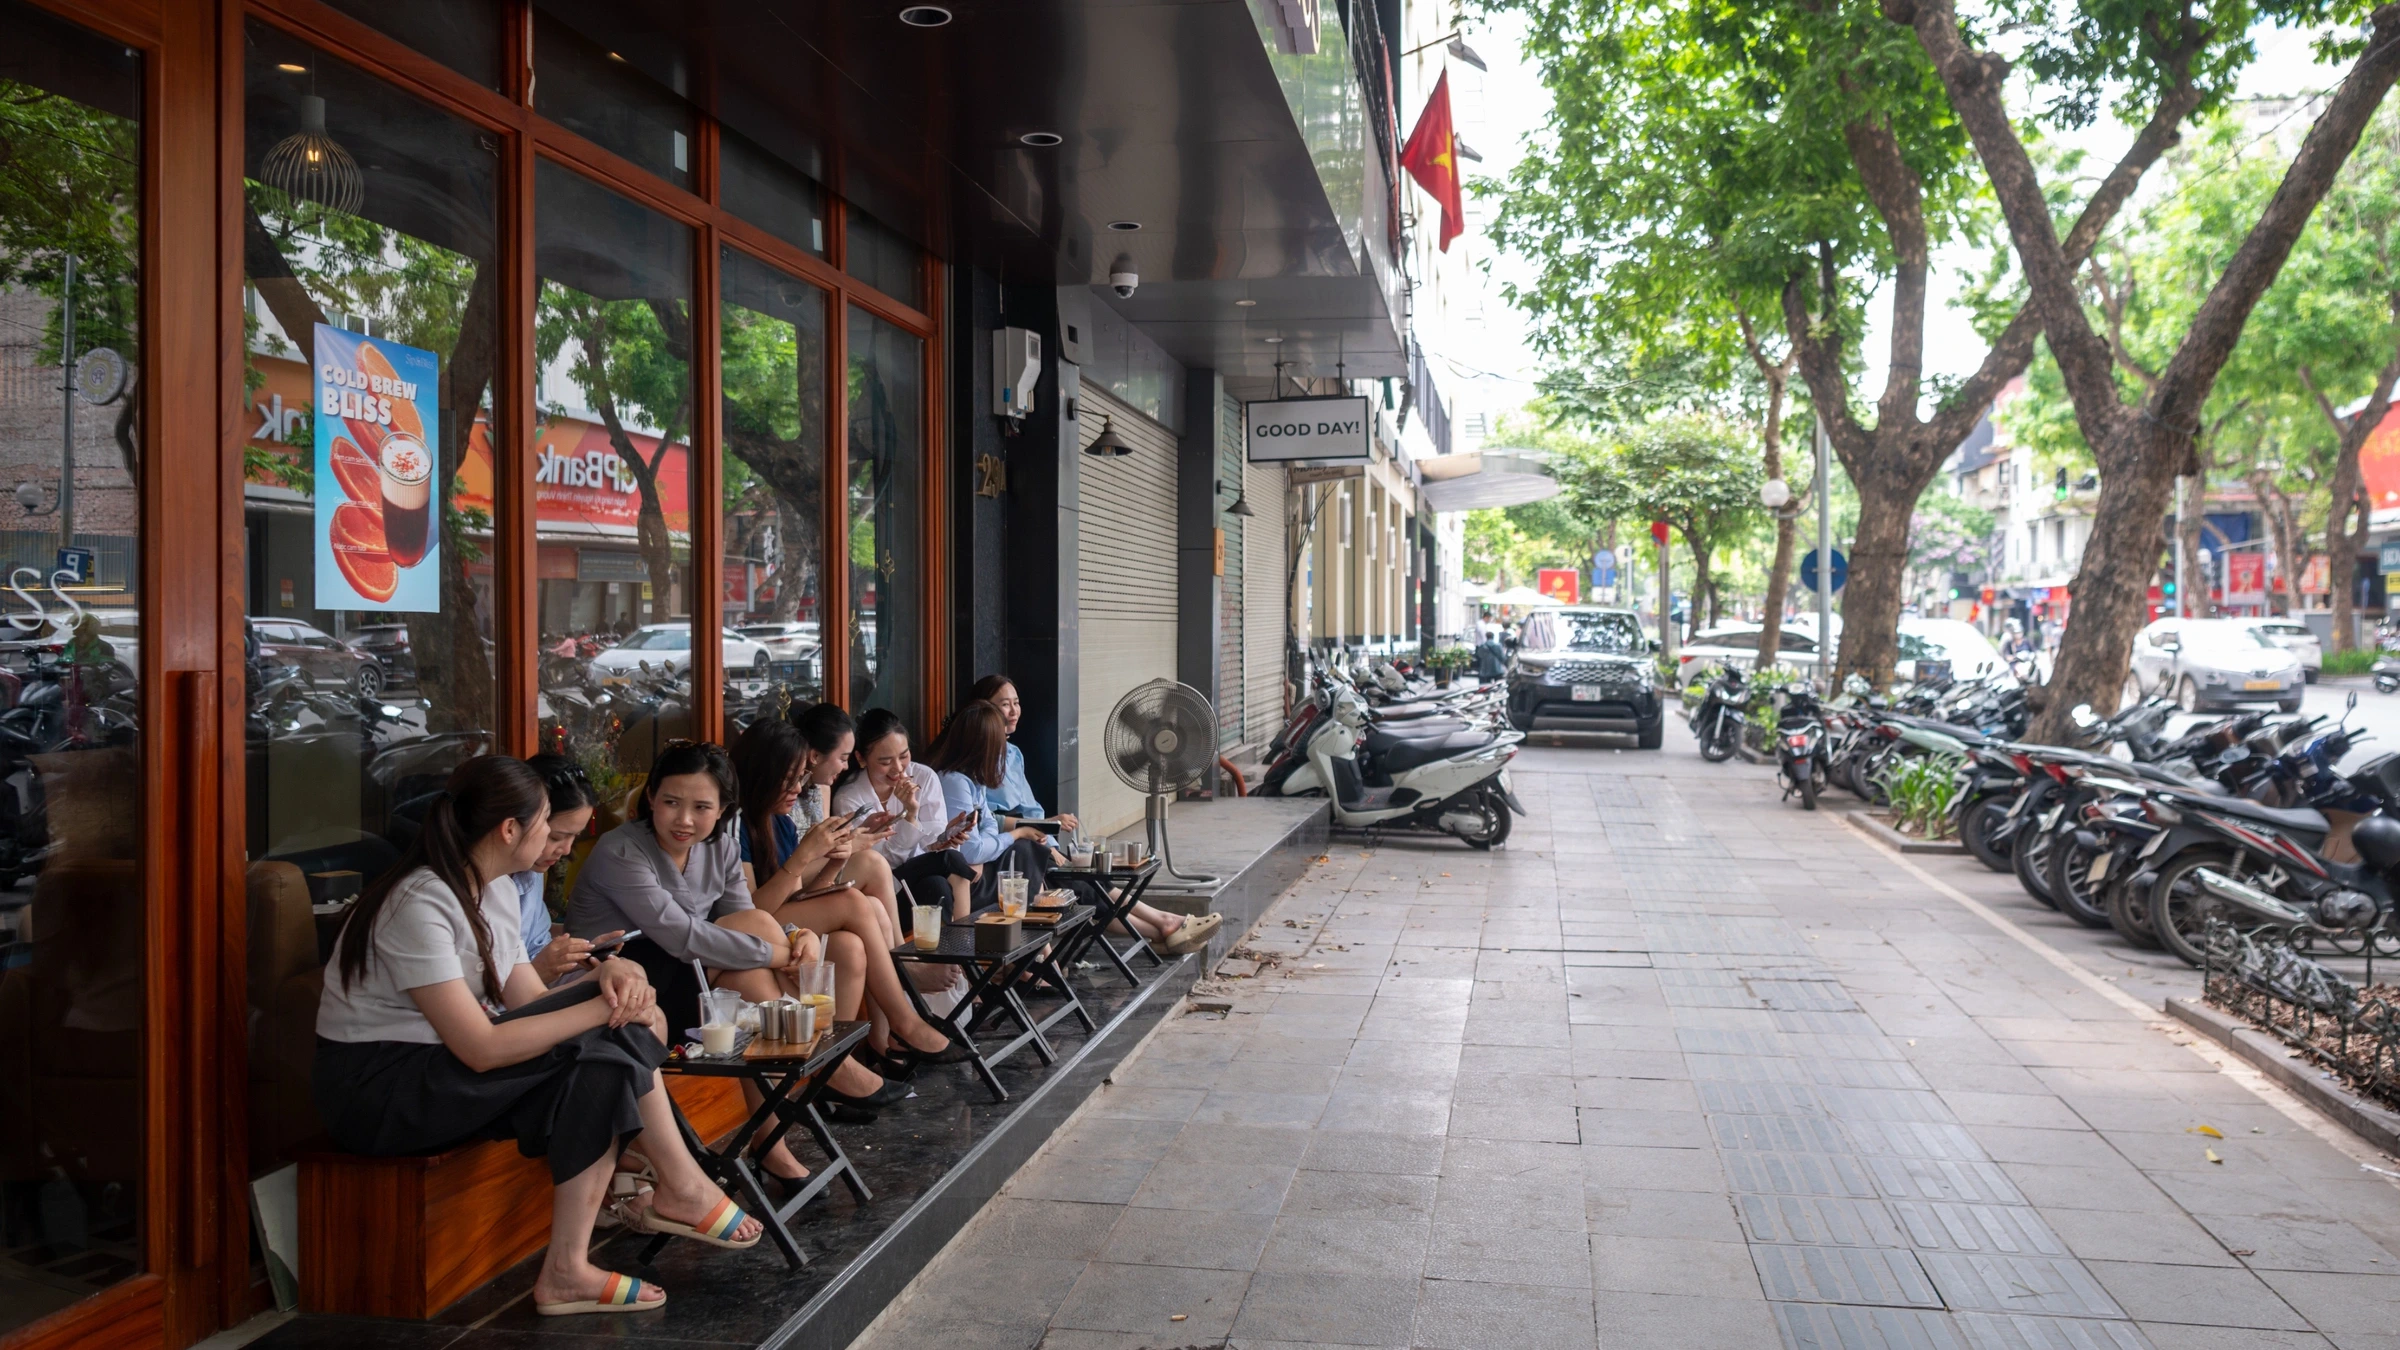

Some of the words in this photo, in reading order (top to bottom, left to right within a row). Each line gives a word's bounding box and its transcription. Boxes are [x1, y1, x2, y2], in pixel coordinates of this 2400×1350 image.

[322, 364, 369, 390] COLD
[371, 374, 418, 401] BREW
[322, 386, 393, 426] BLISS
[1256, 423, 1311, 438] GOOD
[1317, 421, 1360, 436] DAY!
